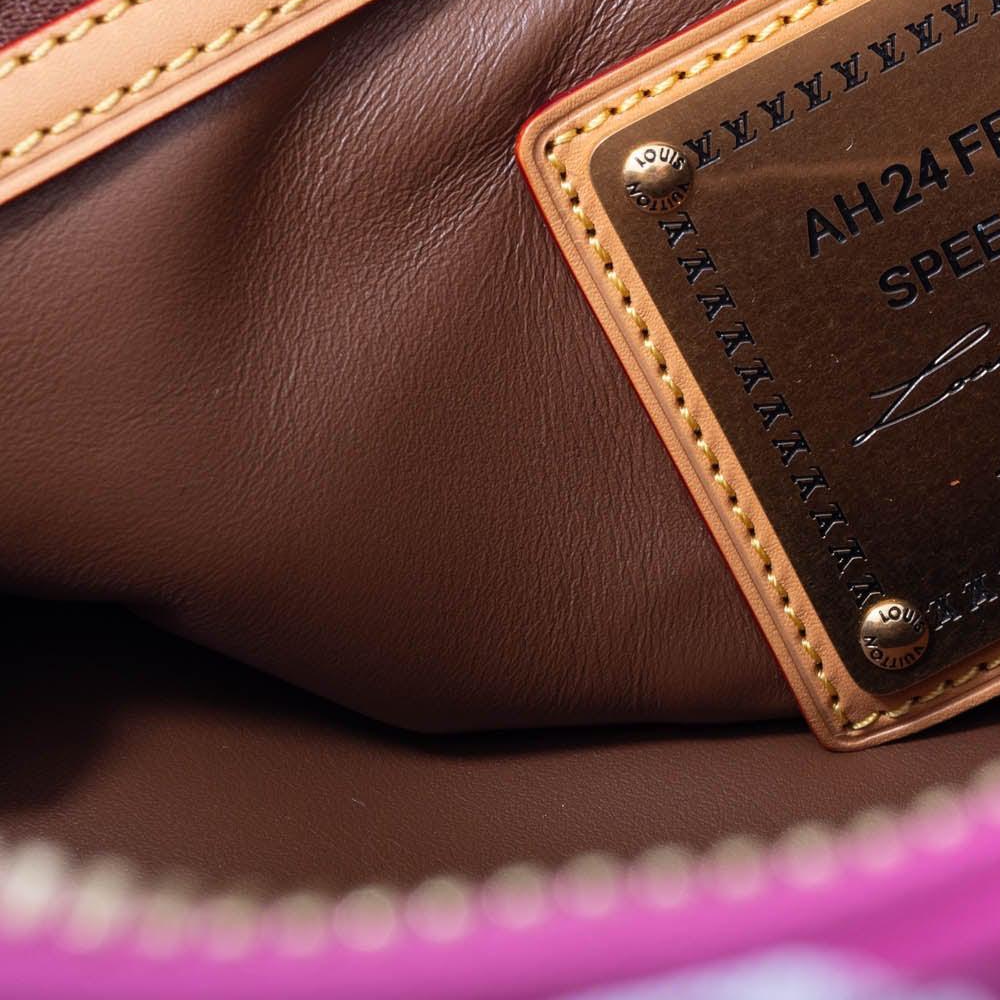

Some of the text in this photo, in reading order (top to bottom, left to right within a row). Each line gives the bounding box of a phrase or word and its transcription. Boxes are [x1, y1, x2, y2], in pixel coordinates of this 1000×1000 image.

[635, 147, 686, 170] LOUIS
[879, 606, 925, 633] LOUIS
[863, 635, 926, 668] VUITTON
